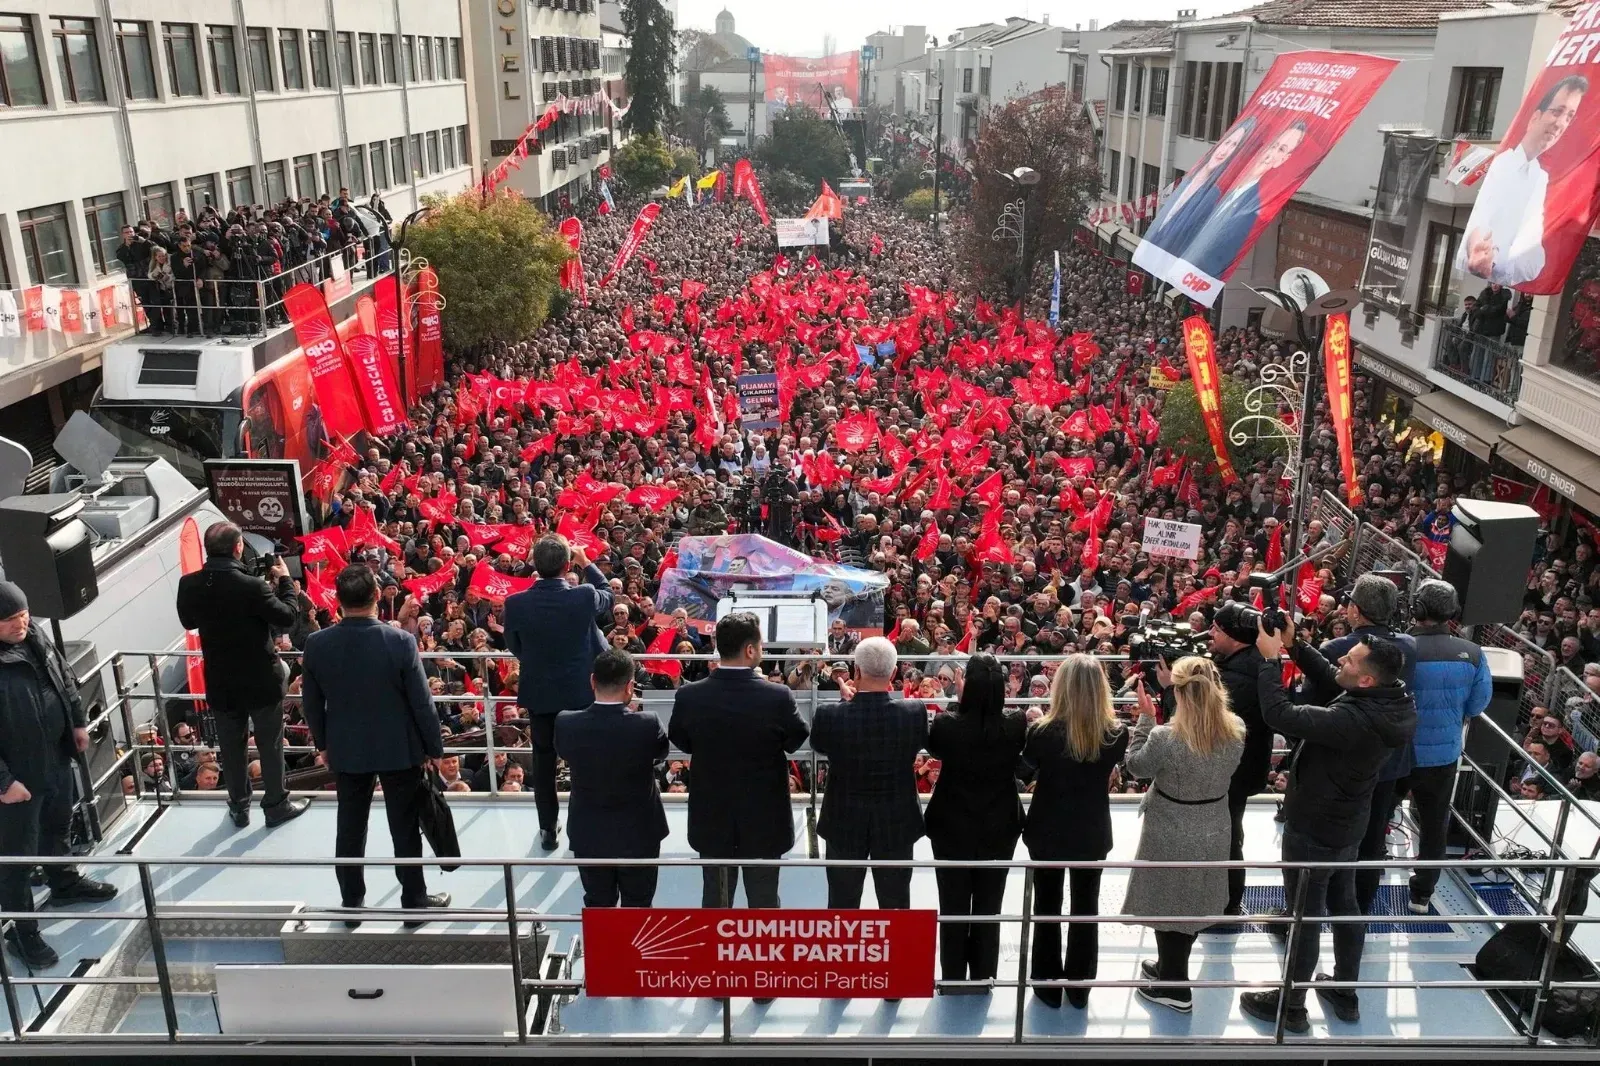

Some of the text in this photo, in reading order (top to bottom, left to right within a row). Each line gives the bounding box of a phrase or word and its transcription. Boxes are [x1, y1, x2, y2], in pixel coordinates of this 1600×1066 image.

[1289, 62, 1327, 75] SERHAD
[1280, 92, 1341, 120] GELDİNİZ
[1182, 272, 1212, 293] CHP
[741, 382, 776, 390] PİJAMAYI
[745, 396, 773, 404] GELDİK
[150, 426, 170, 434] CHP
[1527, 459, 1577, 497] FOTO ENDER
[1148, 520, 1161, 529] HAK
[1143, 536, 1160, 545] ZAFER
[1297, 589, 1311, 604] HP
[717, 914, 891, 939] CUMHURİYET
[718, 939, 890, 962] HALK PARTİSİ
[635, 970, 889, 993] Türkiye'nin Birinci Partisi
